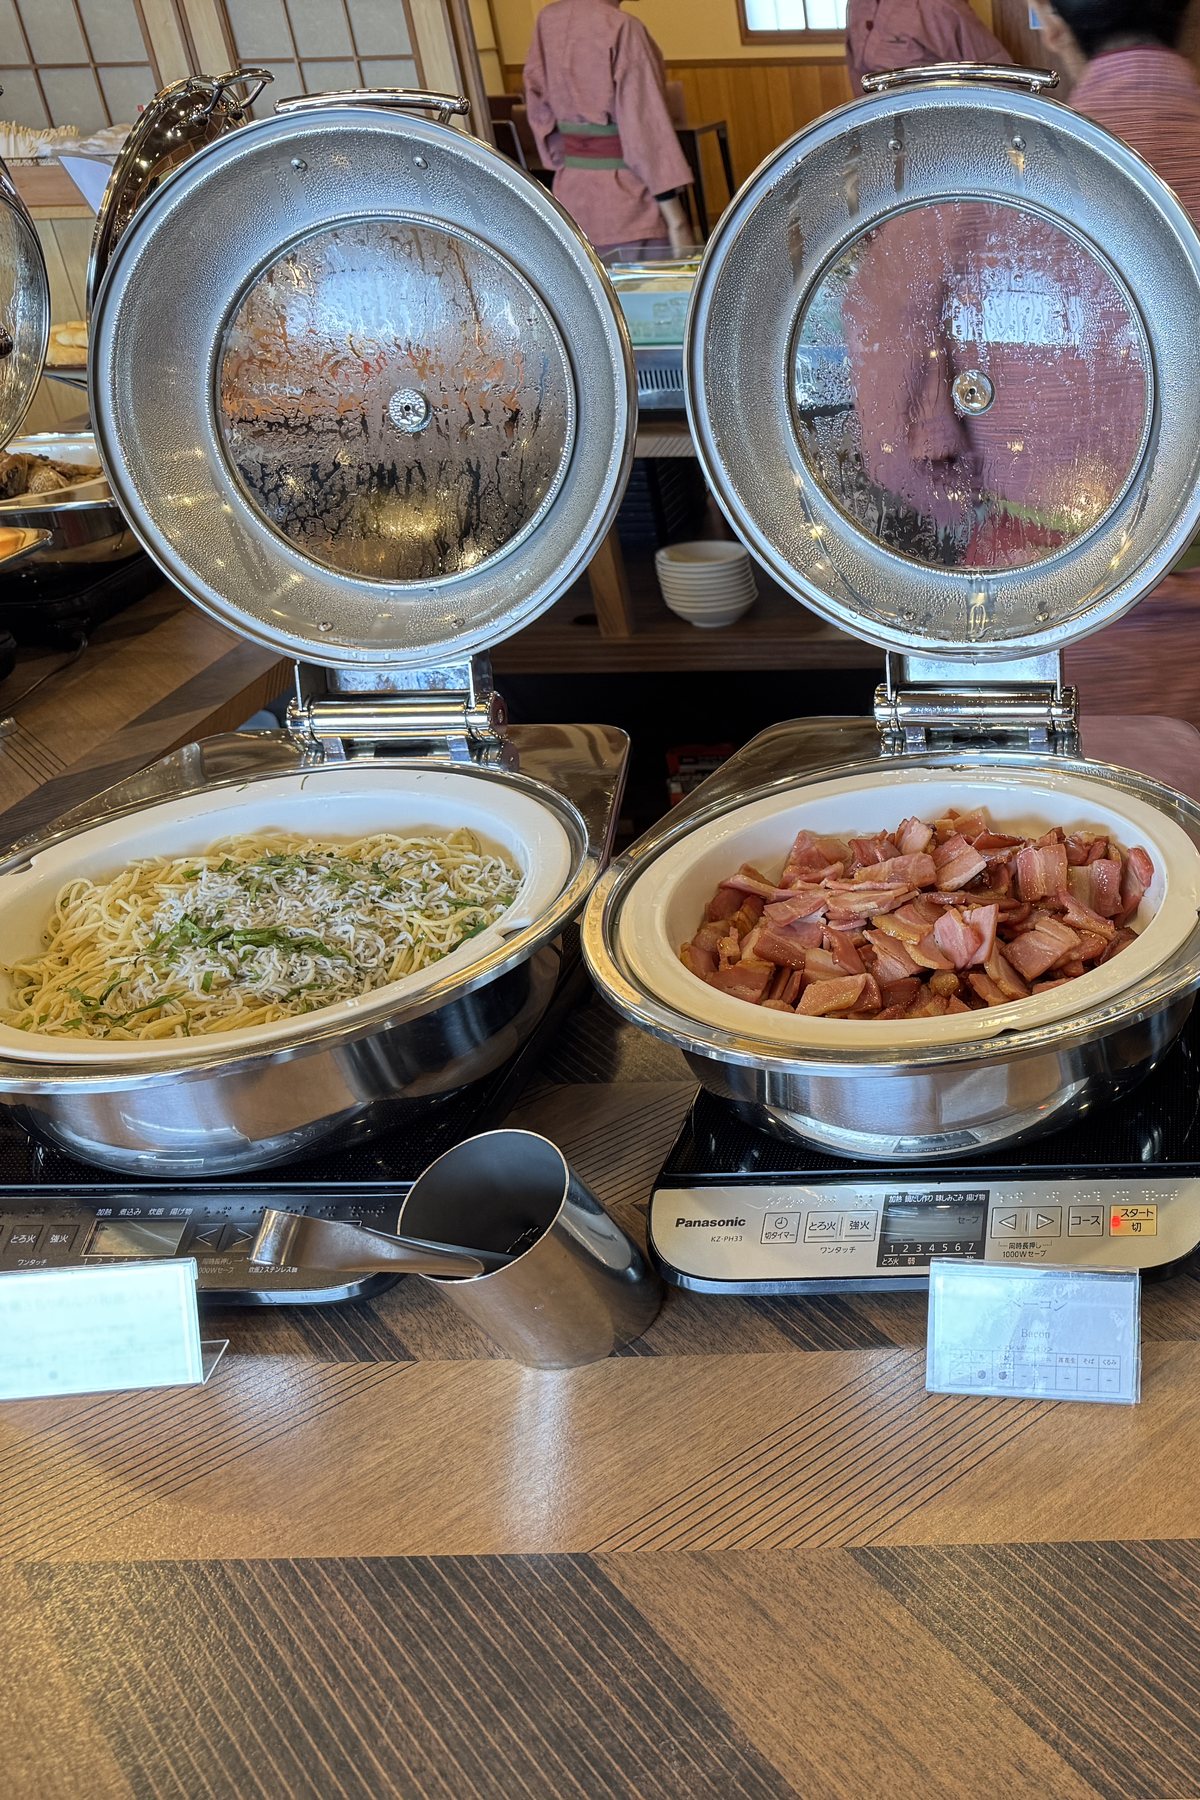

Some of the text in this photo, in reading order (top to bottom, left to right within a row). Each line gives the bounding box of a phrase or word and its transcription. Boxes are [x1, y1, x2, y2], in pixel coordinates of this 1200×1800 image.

[95, 1207, 193, 1216] 加熱 煮込み 炊飯 揚げ物
[1120, 1208, 1154, 1218] スタート
[675, 1216, 746, 1228] Panasonic
[808, 1220, 870, 1231] とろ火 強火
[1071, 1215, 1101, 1226] コース
[1131, 1222, 1142, 1233] 切
[10, 1234, 69, 1244] とろ火 強火
[711, 1235, 743, 1243] KZ-PH33
[764, 1232, 795, 1240] 切タイマー
[820, 1246, 856, 1254] ワンタッチ
[17, 1258, 47, 1266] ワンタッチ
[881, 1258, 900, 1266] とろ火
[1021, 1328, 1051, 1339] Bacon
